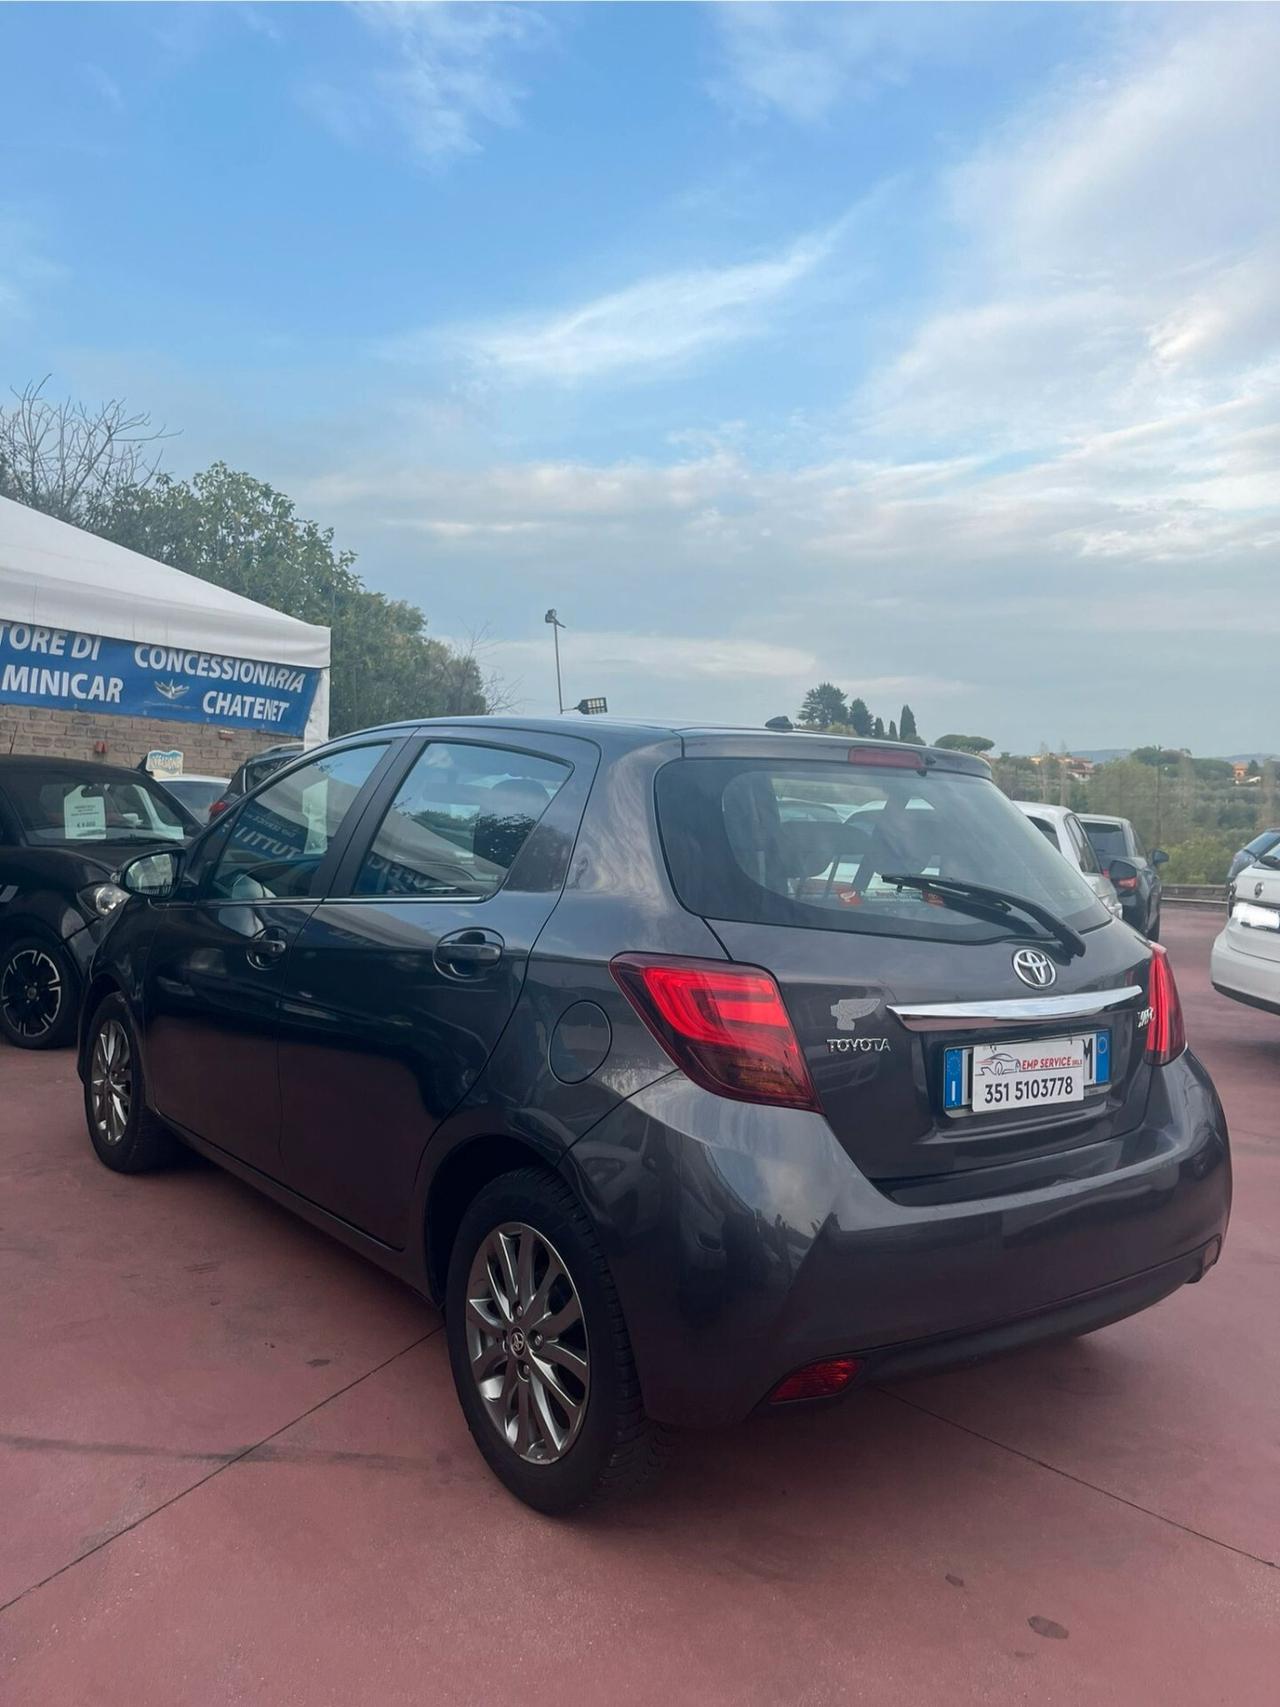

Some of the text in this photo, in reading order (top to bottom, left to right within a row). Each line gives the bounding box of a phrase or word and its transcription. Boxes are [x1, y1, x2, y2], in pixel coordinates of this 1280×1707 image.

[71, 632, 102, 661] DI
[134, 643, 306, 693] CONCESSIONARIA
[1, 664, 124, 703] MINICAR
[202, 691, 290, 722] CHATENET
[826, 1038, 891, 1052] TOYOTA
[1022, 1060, 1039, 1070] EMP
[1040, 1056, 1072, 1069] SERVICE
[984, 1076, 1074, 1104] 351 5103778
